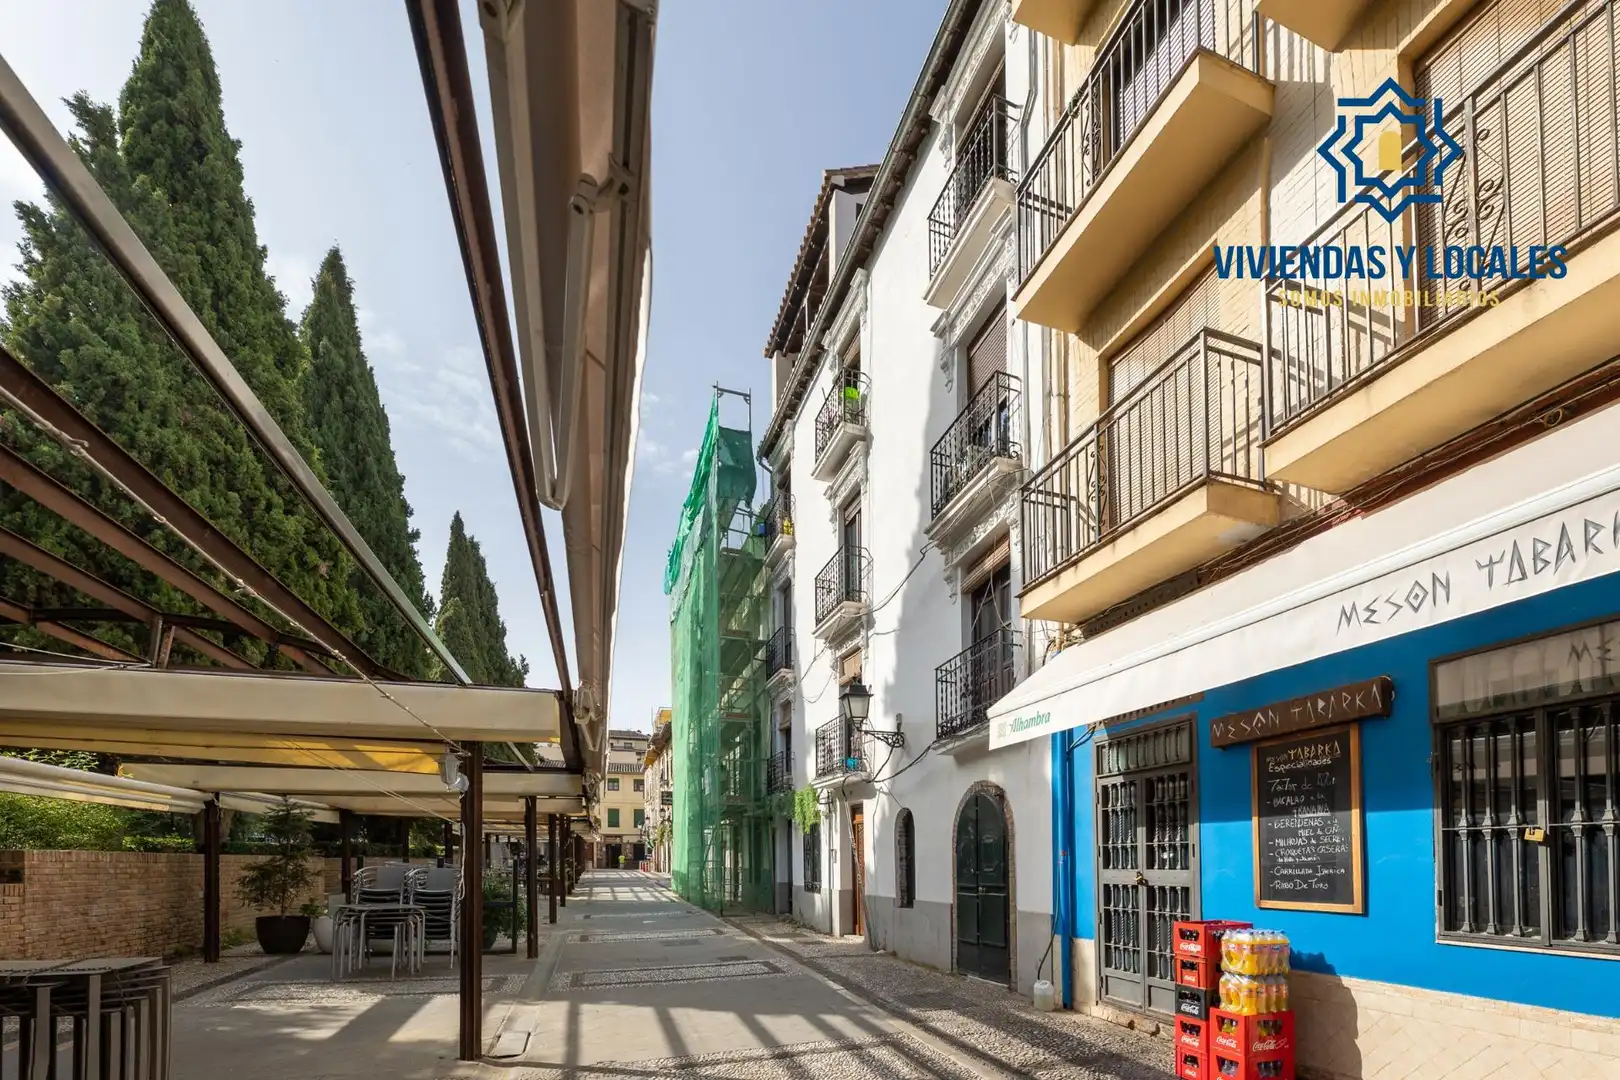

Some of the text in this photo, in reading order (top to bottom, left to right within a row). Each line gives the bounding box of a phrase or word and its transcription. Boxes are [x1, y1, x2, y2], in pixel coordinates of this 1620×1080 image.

[1337, 571, 1450, 635] MESON
[1009, 711, 1051, 736] Alhambra
[1212, 684, 1382, 739] MESON TABARKA
